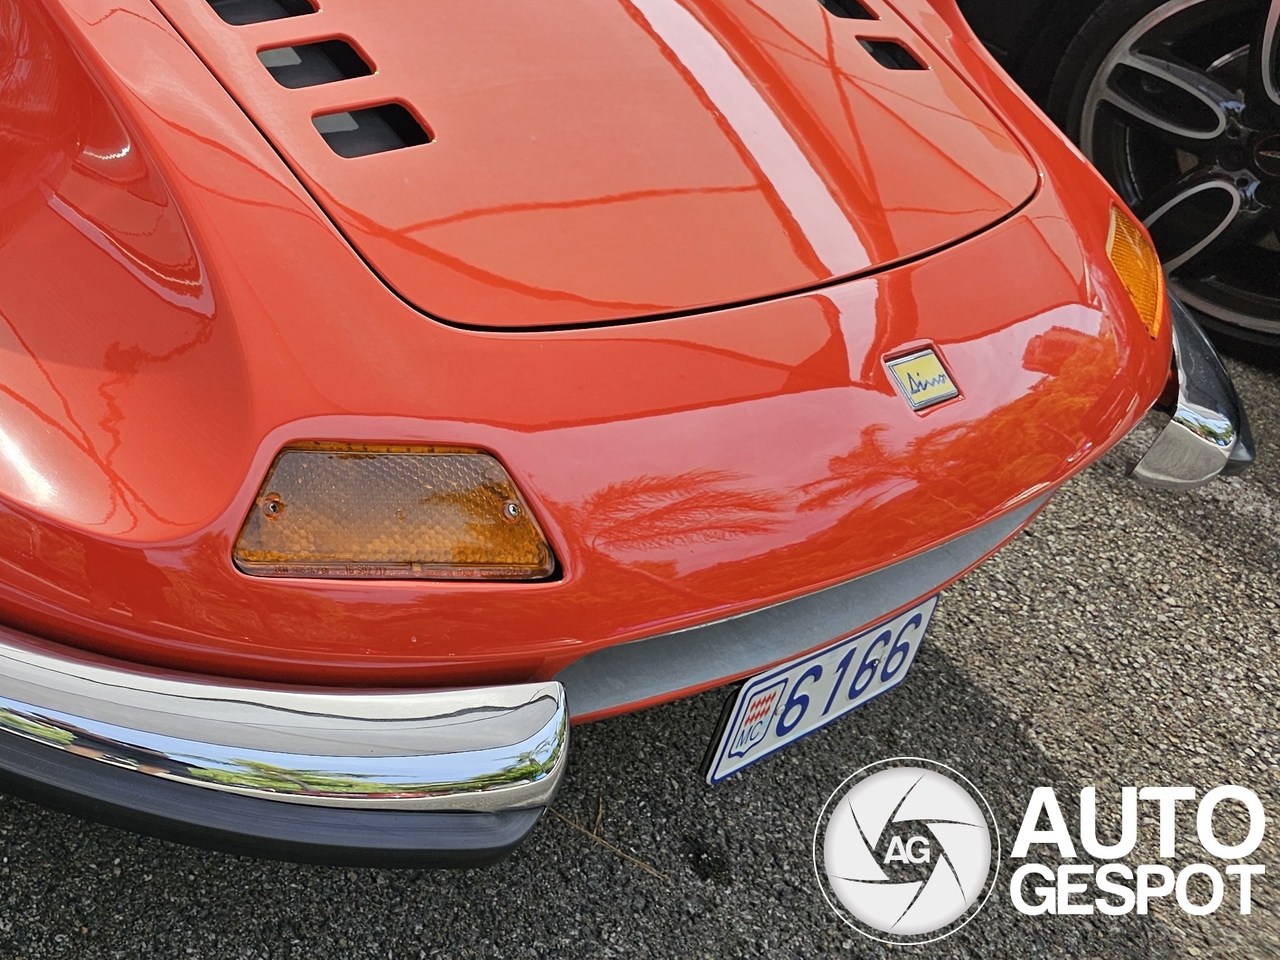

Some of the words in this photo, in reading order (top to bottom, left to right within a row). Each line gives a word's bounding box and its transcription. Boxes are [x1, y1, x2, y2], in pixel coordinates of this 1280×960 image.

[907, 371, 947, 395] Dino
[775, 612, 923, 738] 6166
[734, 720, 764, 749] MC
